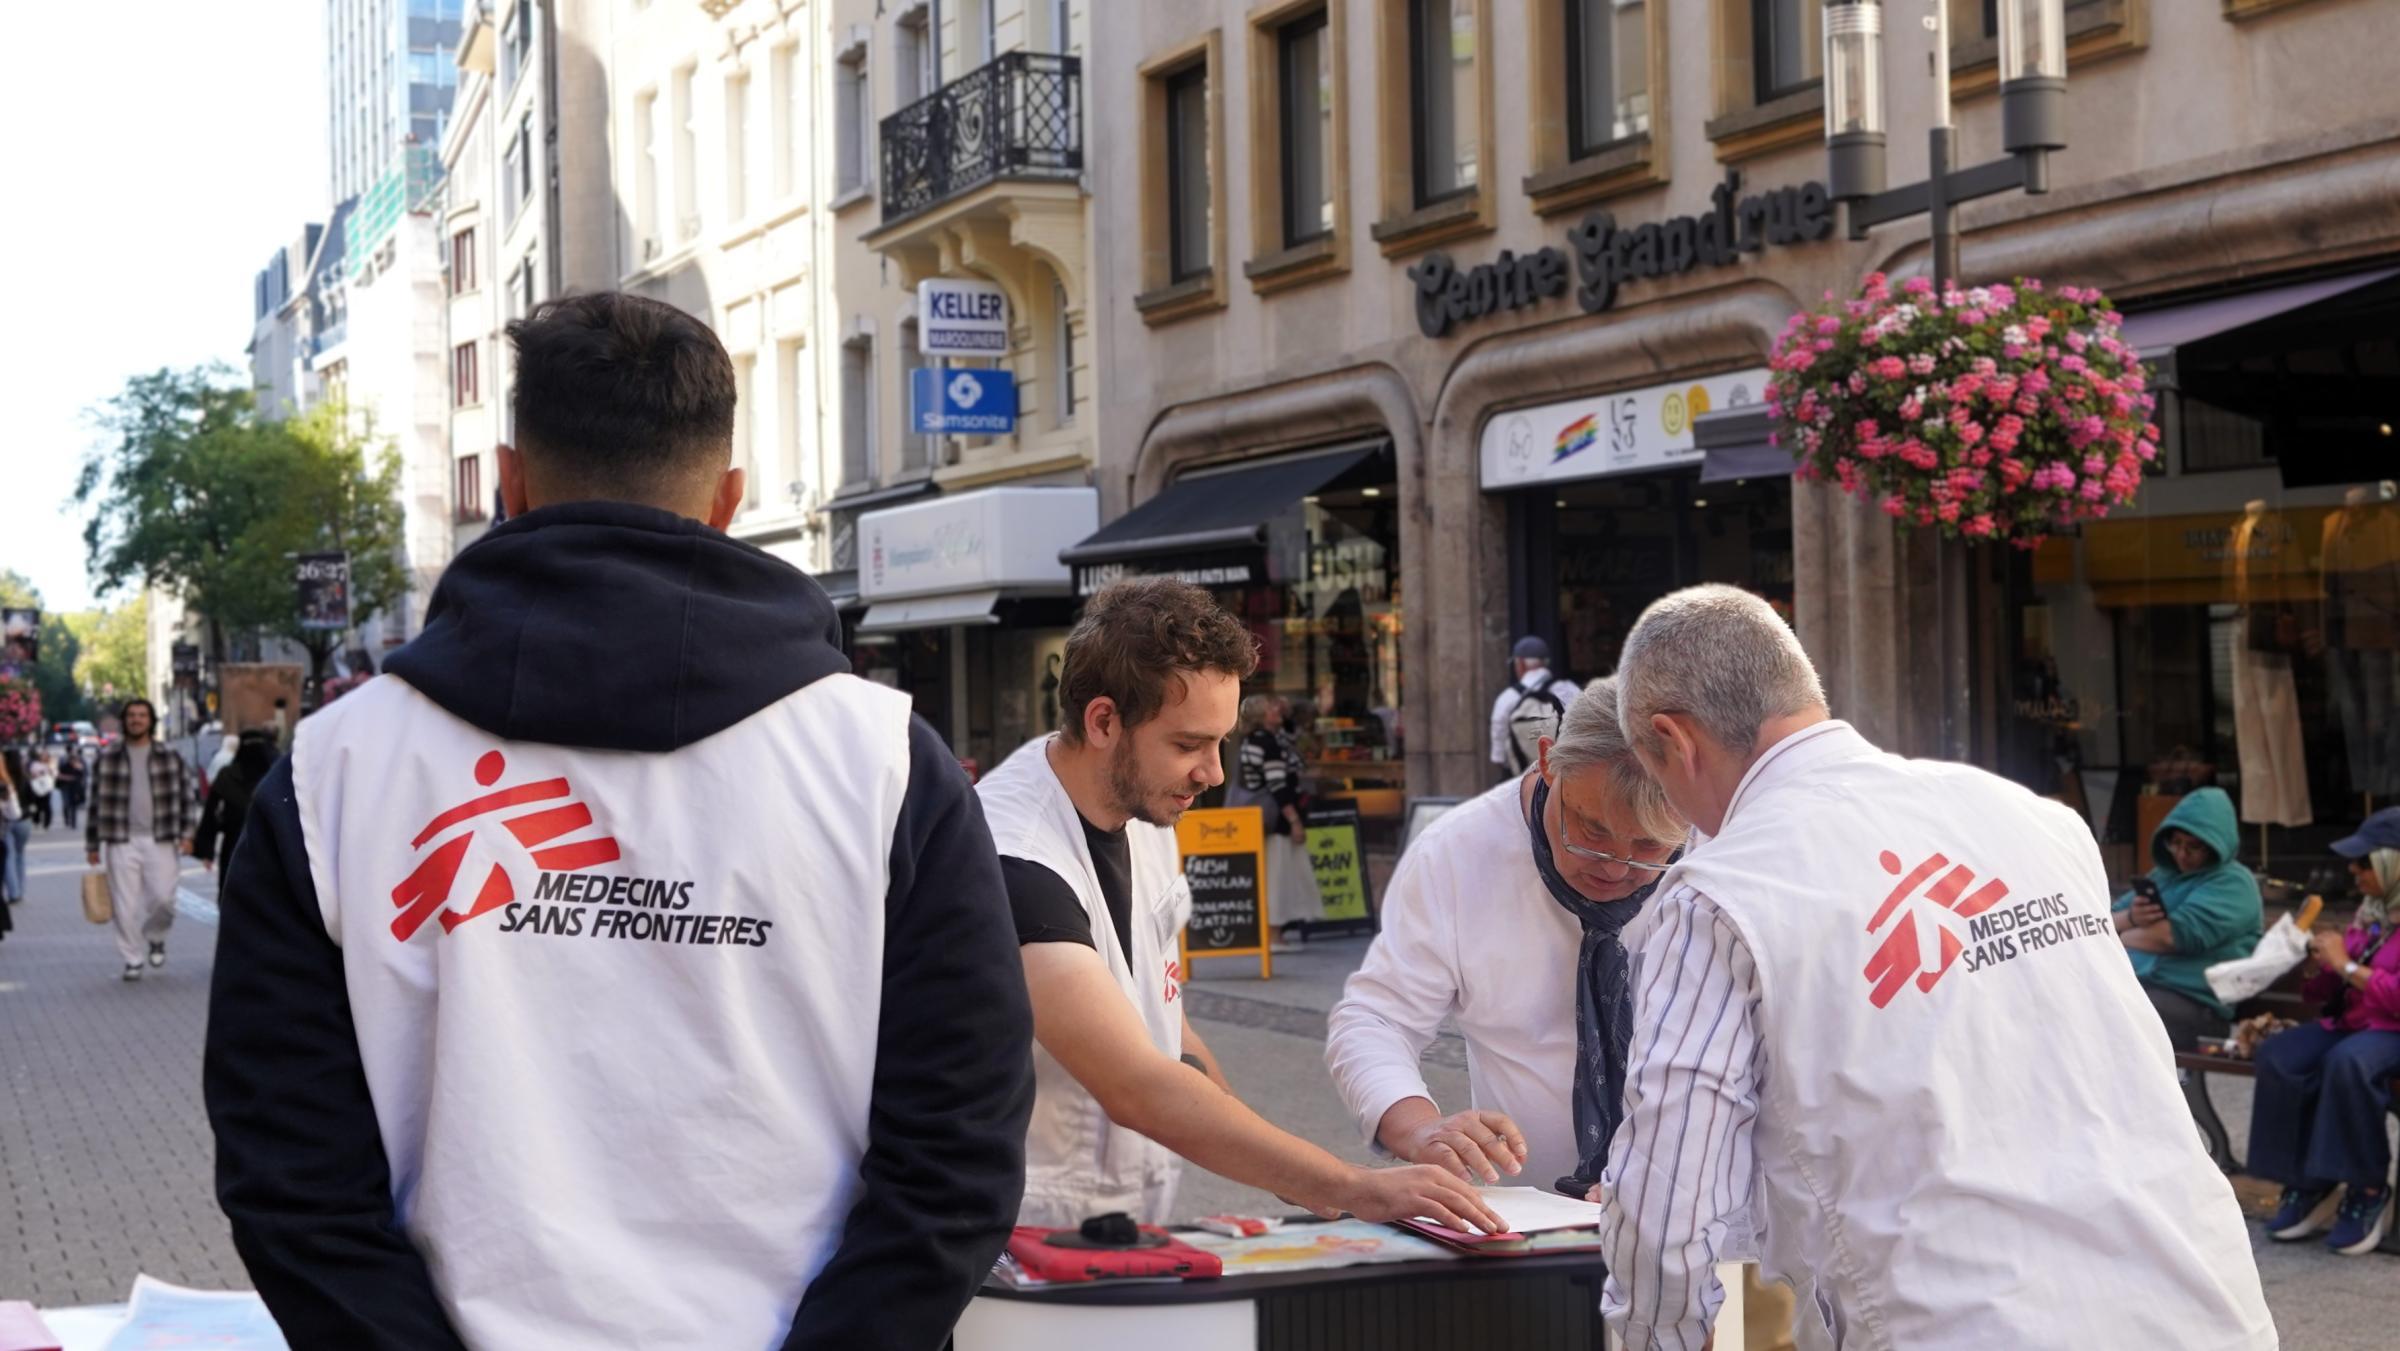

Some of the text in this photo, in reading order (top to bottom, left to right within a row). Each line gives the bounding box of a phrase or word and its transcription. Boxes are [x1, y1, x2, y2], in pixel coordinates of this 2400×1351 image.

[930, 291, 1003, 321] KELLER
[1408, 246, 1568, 338] Centre
[923, 411, 1008, 431] Samsonite
[534, 872, 694, 910] MEDECINS
[499, 903, 773, 947] SANS FRONTIERES
[1969, 893, 2069, 943] MEDECINS
[1962, 935, 2017, 973] SANS
